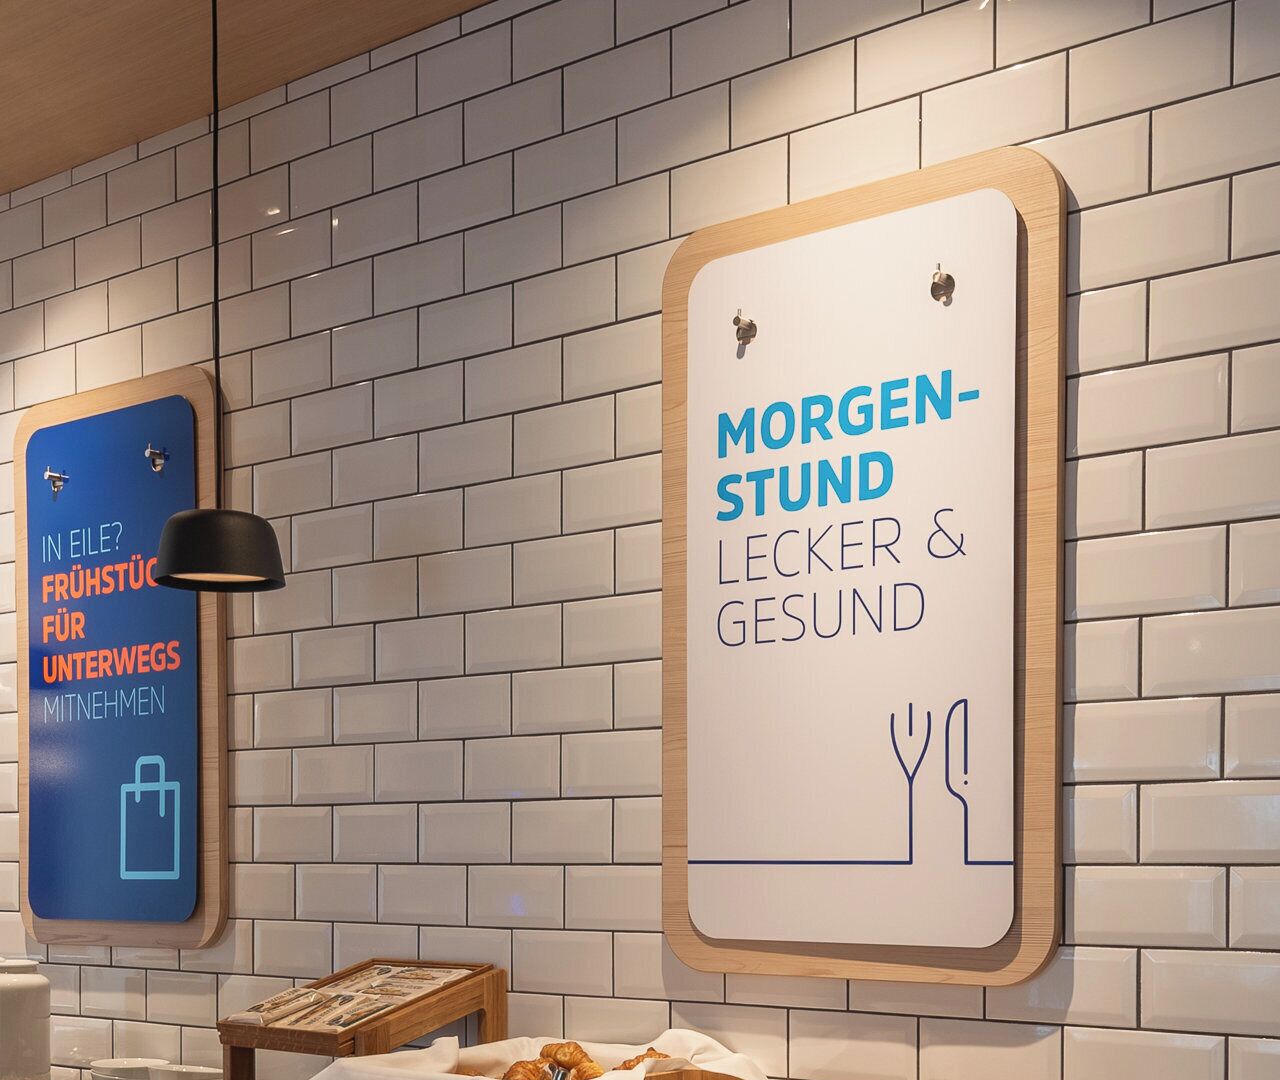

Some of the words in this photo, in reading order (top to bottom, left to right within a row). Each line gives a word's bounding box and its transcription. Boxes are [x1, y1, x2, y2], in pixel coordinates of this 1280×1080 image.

[717, 369, 981, 459] MORGEN-
[716, 450, 895, 522] STUND
[42, 532, 62, 564] IN
[69, 521, 123, 559] EILE?
[718, 516, 902, 586] LECKER
[926, 507, 967, 560] &
[41, 553, 160, 604] FRÜHSTÜC
[41, 607, 86, 645] FÜR
[716, 582, 925, 648] GESUND
[42, 640, 182, 685] UNTERWEGS
[43, 684, 165, 724] MITNEHMEN
